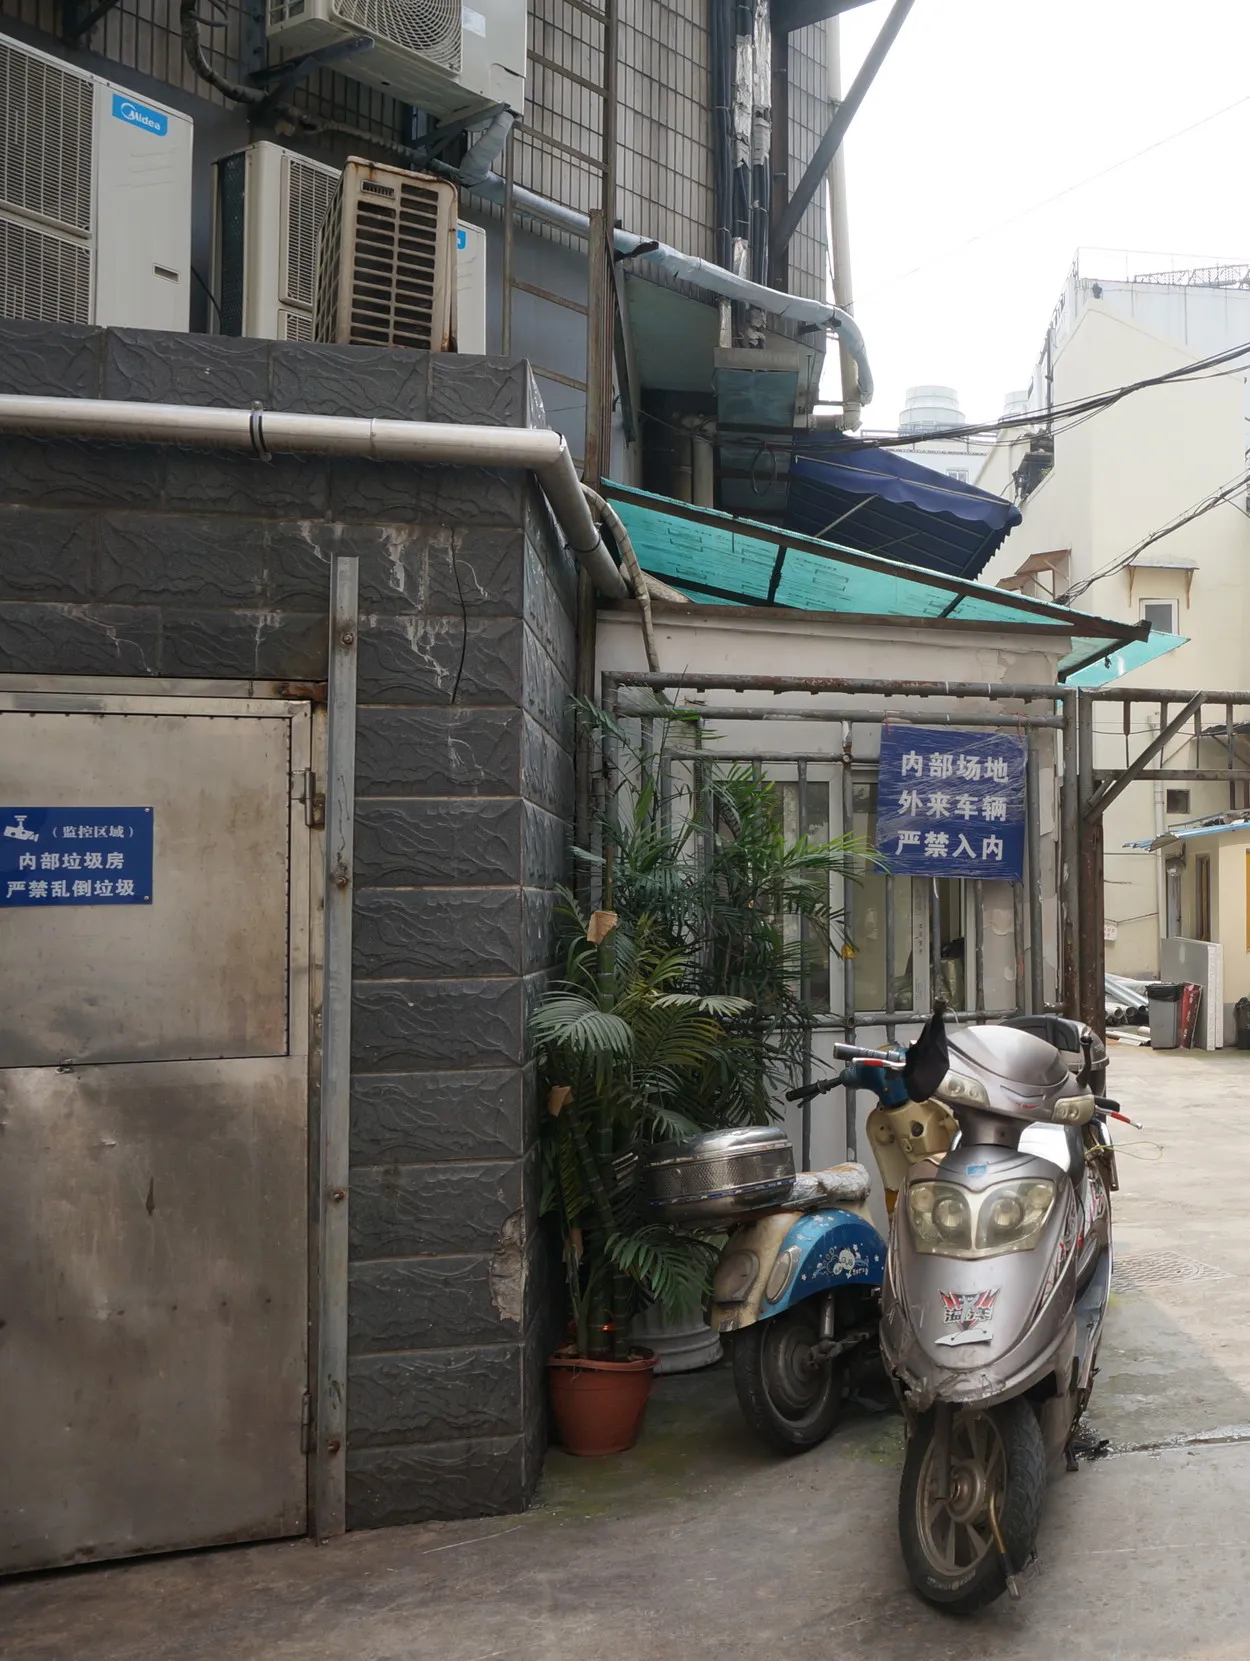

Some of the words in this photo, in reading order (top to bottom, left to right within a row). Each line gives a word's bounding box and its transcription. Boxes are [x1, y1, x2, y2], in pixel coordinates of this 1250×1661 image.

[121, 102, 161, 131] Midea
[901, 750, 1010, 783] 内部场地
[898, 789, 1008, 822] 外来车辆
[52, 825, 134, 838] （监控区域）
[894, 830, 1004, 861] 严禁入内
[19, 852, 125, 871] 内部垃圾房
[6, 879, 135, 898] 严禁乱倒垃圾
